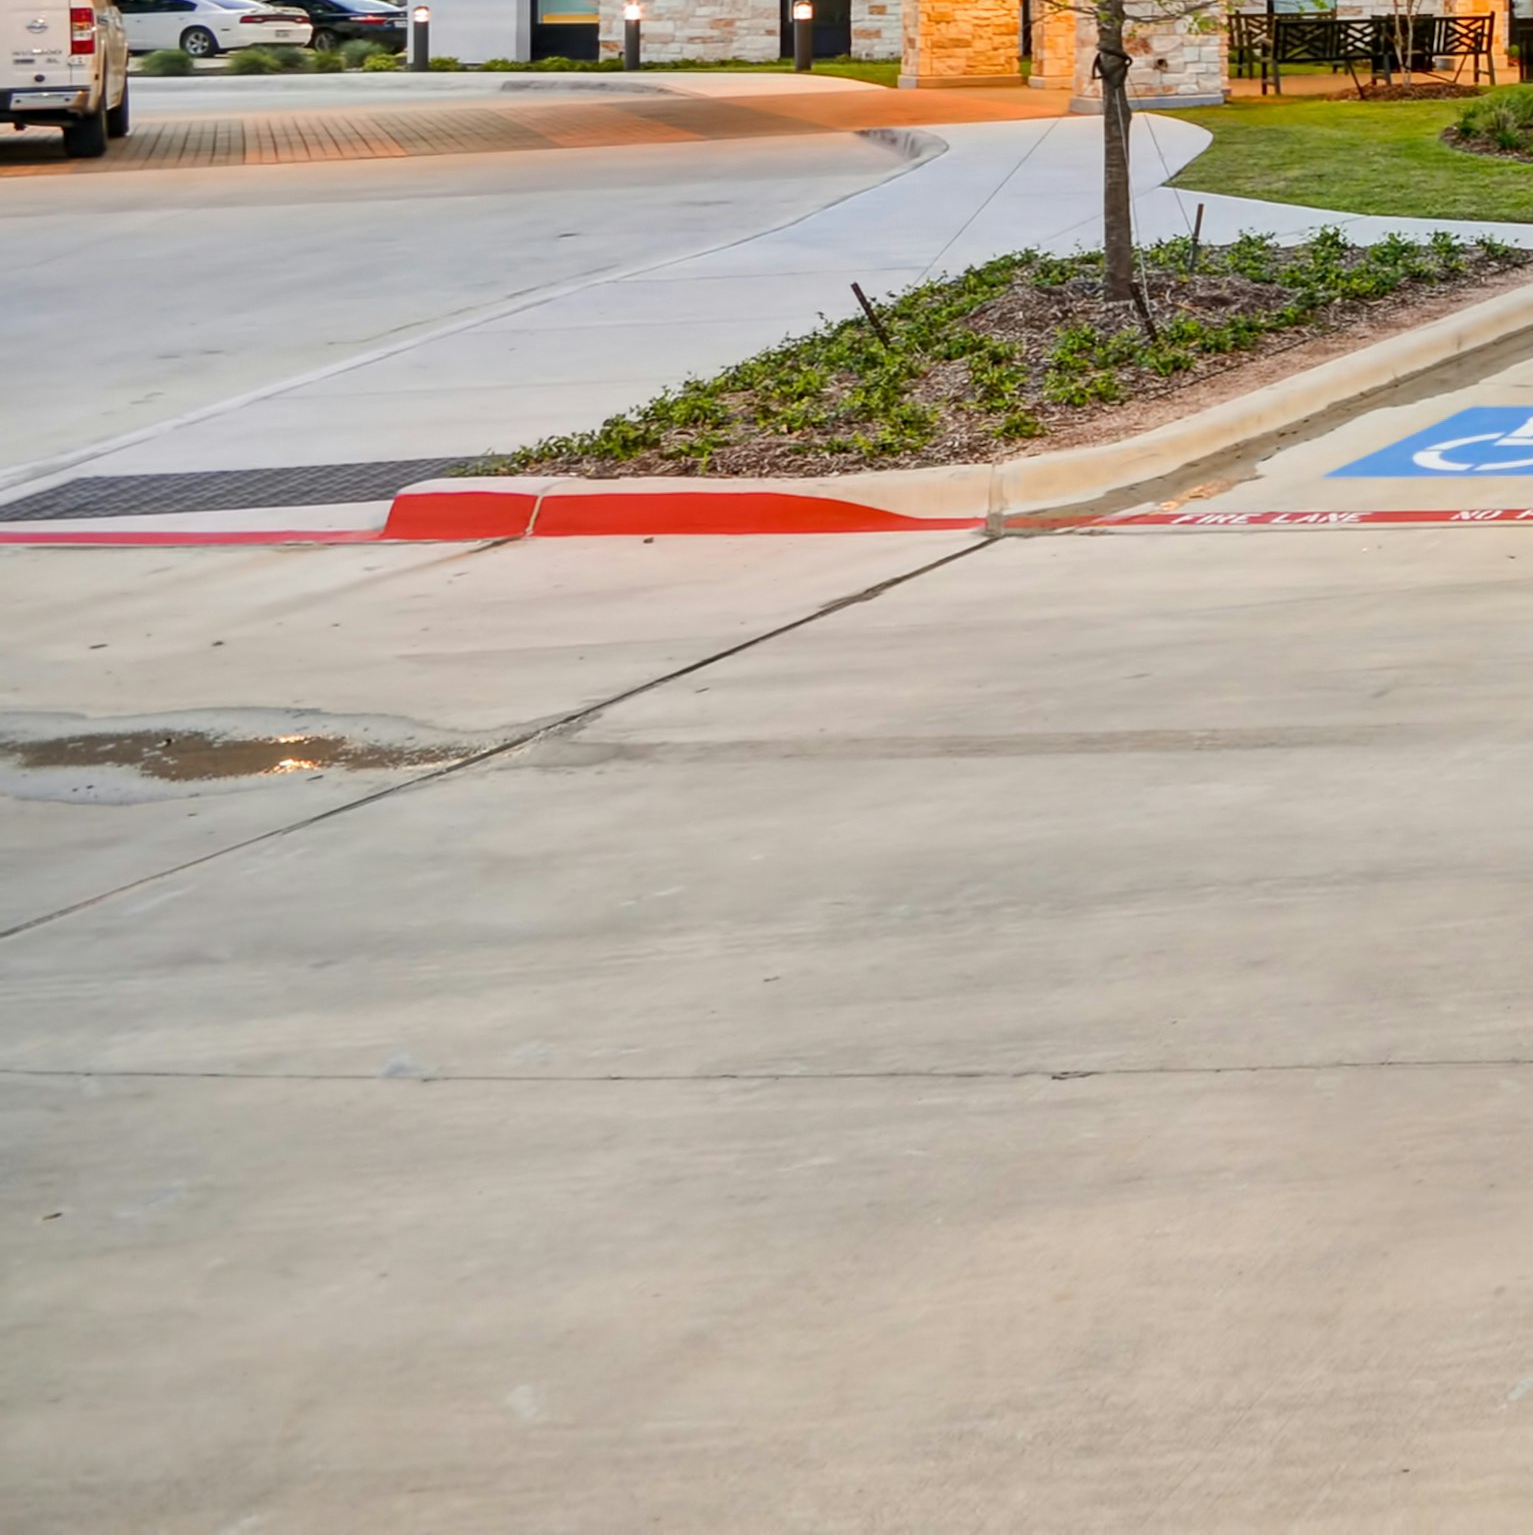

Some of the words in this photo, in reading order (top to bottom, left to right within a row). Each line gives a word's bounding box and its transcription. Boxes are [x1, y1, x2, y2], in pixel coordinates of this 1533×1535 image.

[1170, 513, 1264, 525] FIRE
[1270, 511, 1375, 524] LANE
[1450, 509, 1503, 521] NO
